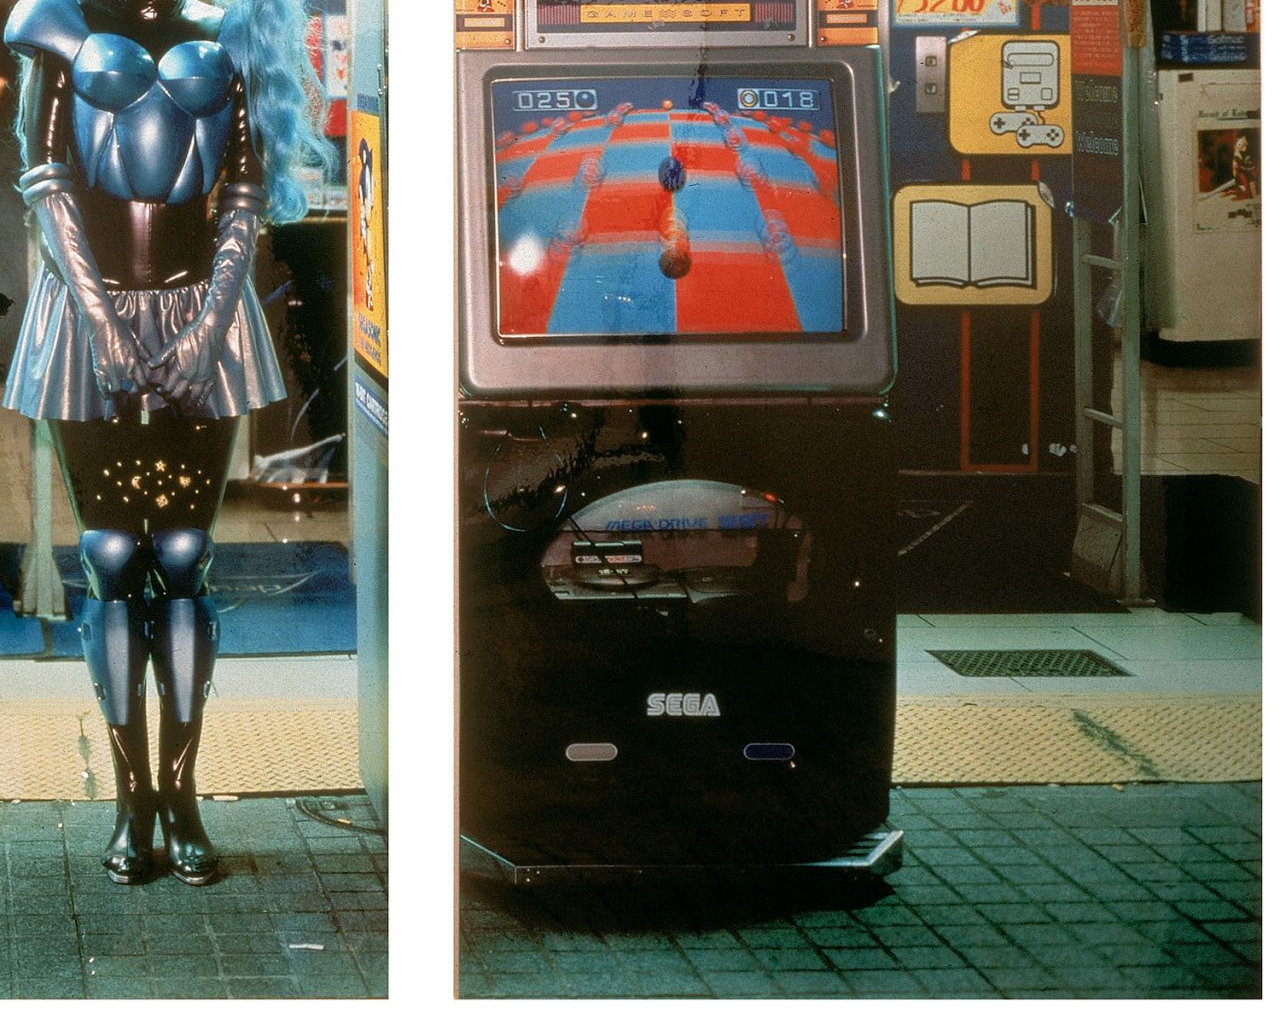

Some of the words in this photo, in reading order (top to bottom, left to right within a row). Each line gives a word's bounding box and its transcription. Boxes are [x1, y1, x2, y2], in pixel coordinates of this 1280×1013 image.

[587, 9, 651, 19] GAME
[683, 8, 747, 19] SOFT
[518, 92, 570, 109] 025
[763, 91, 814, 107] 018
[647, 693, 721, 717] SEGA
